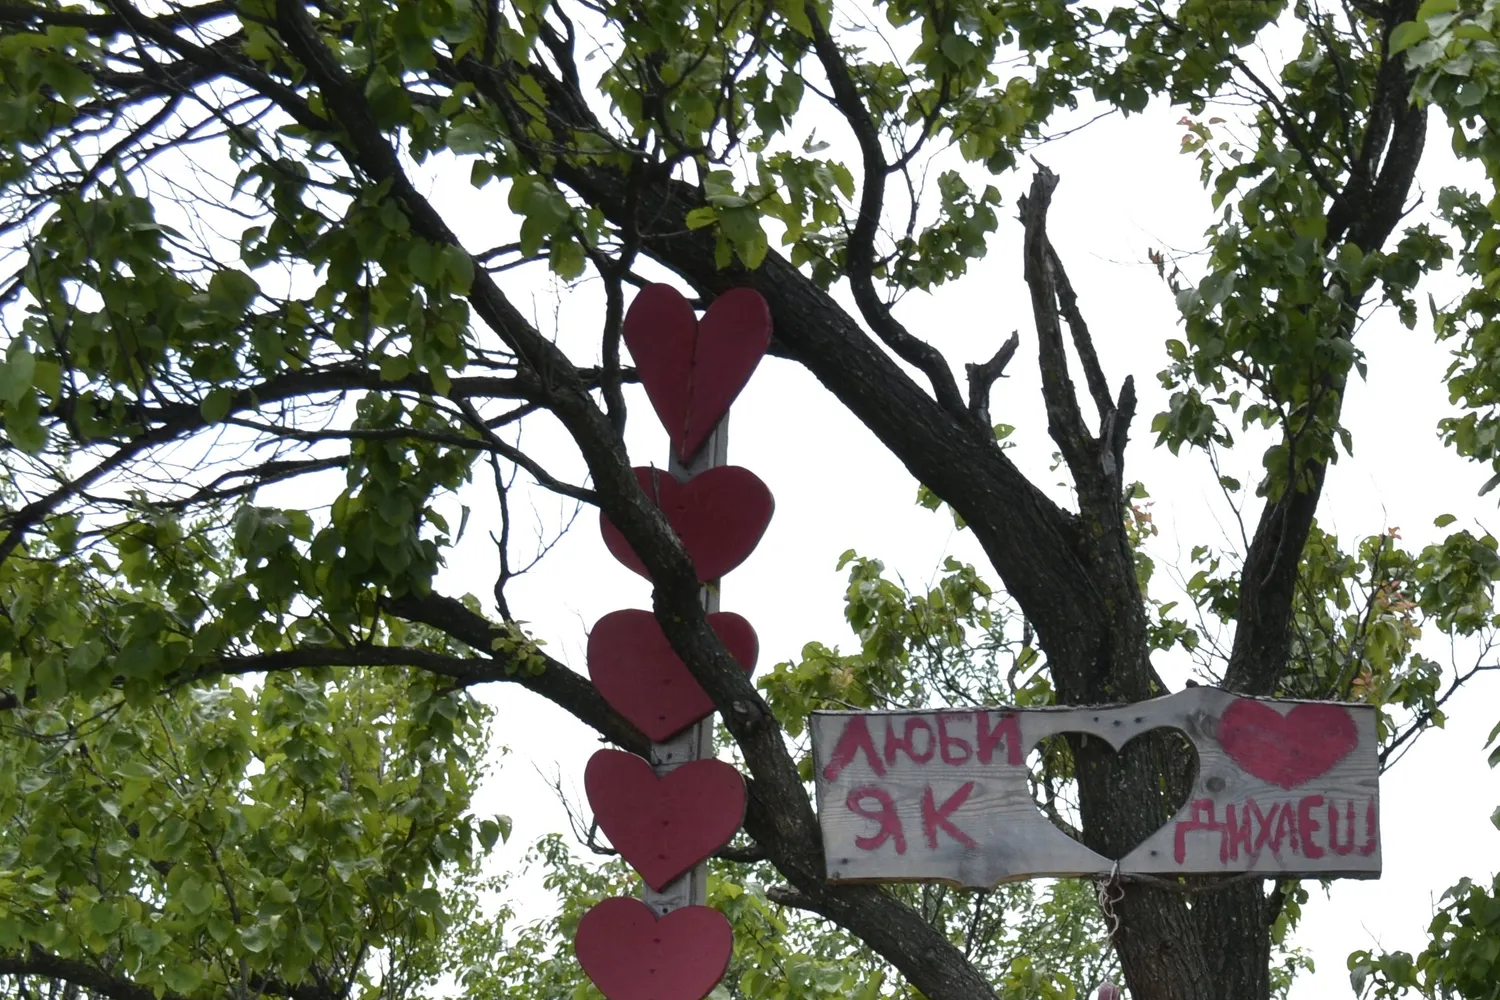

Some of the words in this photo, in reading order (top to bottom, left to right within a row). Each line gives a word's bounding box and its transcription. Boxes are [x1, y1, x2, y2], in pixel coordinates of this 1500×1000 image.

[824, 711, 1024, 781] ЛЮБИ
[846, 781, 977, 854] ЯК
[1174, 795, 1376, 865] ДИХАЕШ
